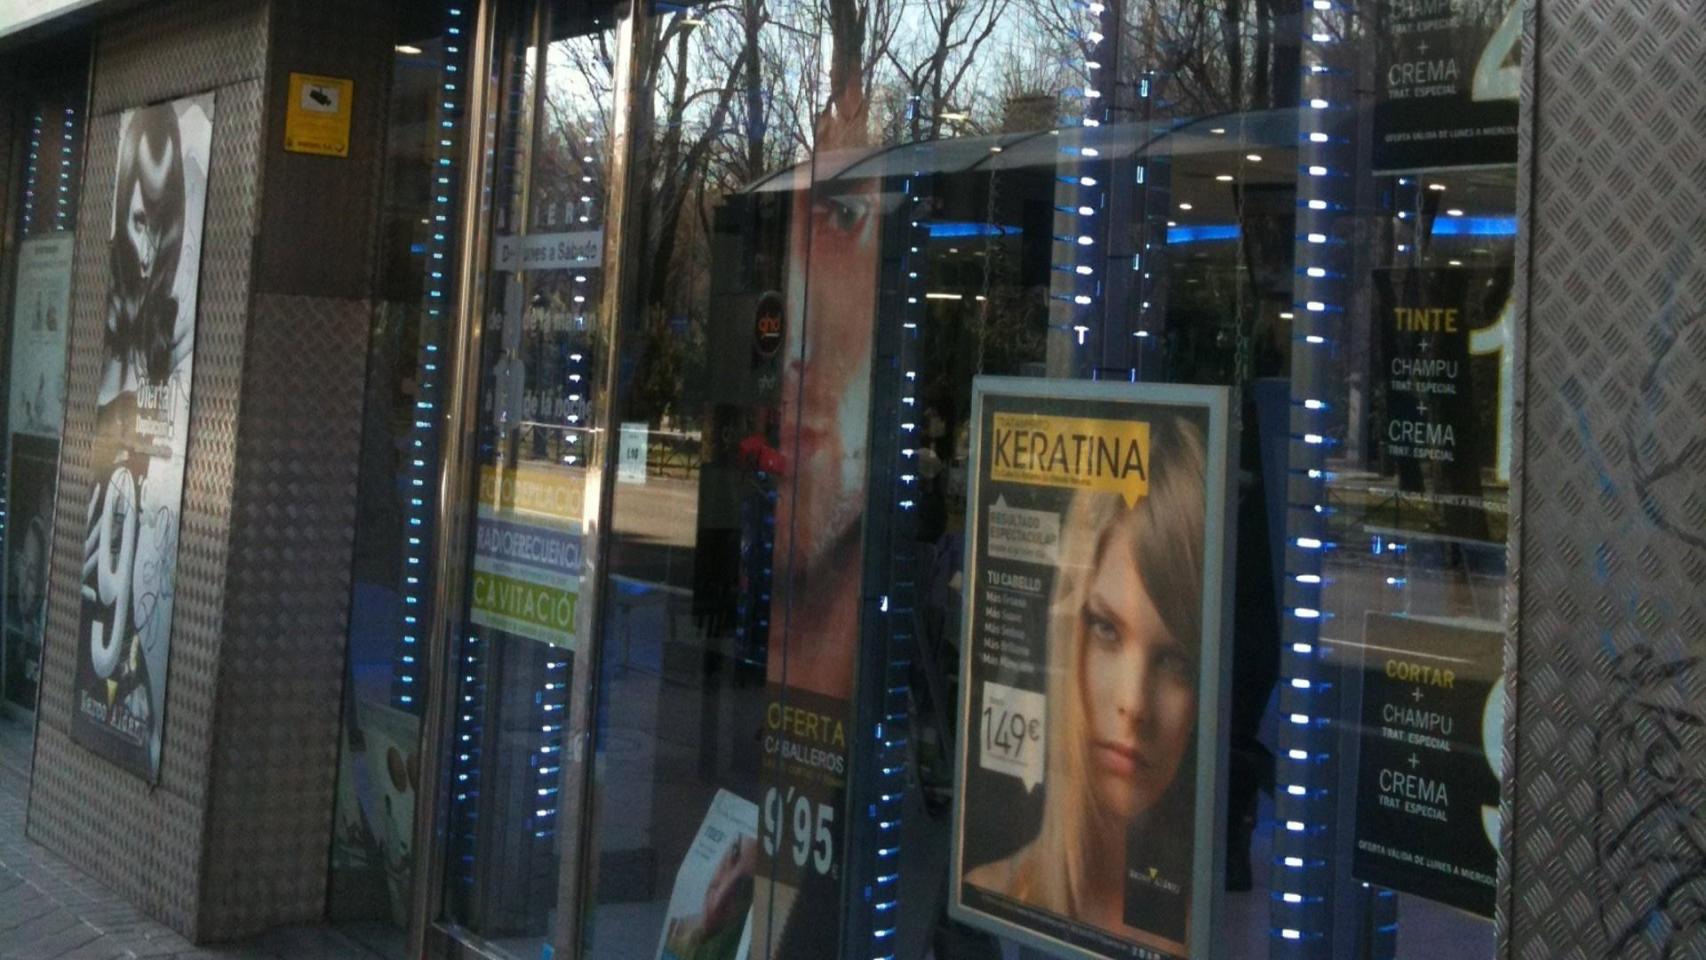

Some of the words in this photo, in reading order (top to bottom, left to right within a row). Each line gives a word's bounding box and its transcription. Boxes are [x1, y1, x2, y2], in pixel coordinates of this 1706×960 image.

[1388, 57, 1458, 87] CREMA
[1414, 84, 1457, 97] ESPECIAL
[1393, 307, 1458, 333] TINTE
[1391, 357, 1458, 379] CHAMPU
[1416, 381, 1457, 395] ESPECIAL
[1388, 419, 1456, 447] CREMA
[994, 428, 1147, 482] KERATINA
[1413, 447, 1455, 462] ESPECIAL
[988, 569, 1000, 585] TU
[1001, 572, 1042, 592] CABELLO
[474, 576, 578, 628] CAVITACIÓ
[1386, 658, 1455, 689] CORTAR
[767, 702, 846, 747] OFERTA
[982, 705, 1040, 759] 149€
[1383, 703, 1451, 736] CHAMPU
[1408, 733, 1451, 752] ESPECIAL
[1379, 768, 1449, 807] CREMA
[1404, 803, 1448, 823] ESPECIAL
[1414, 854, 1424, 866] DE
